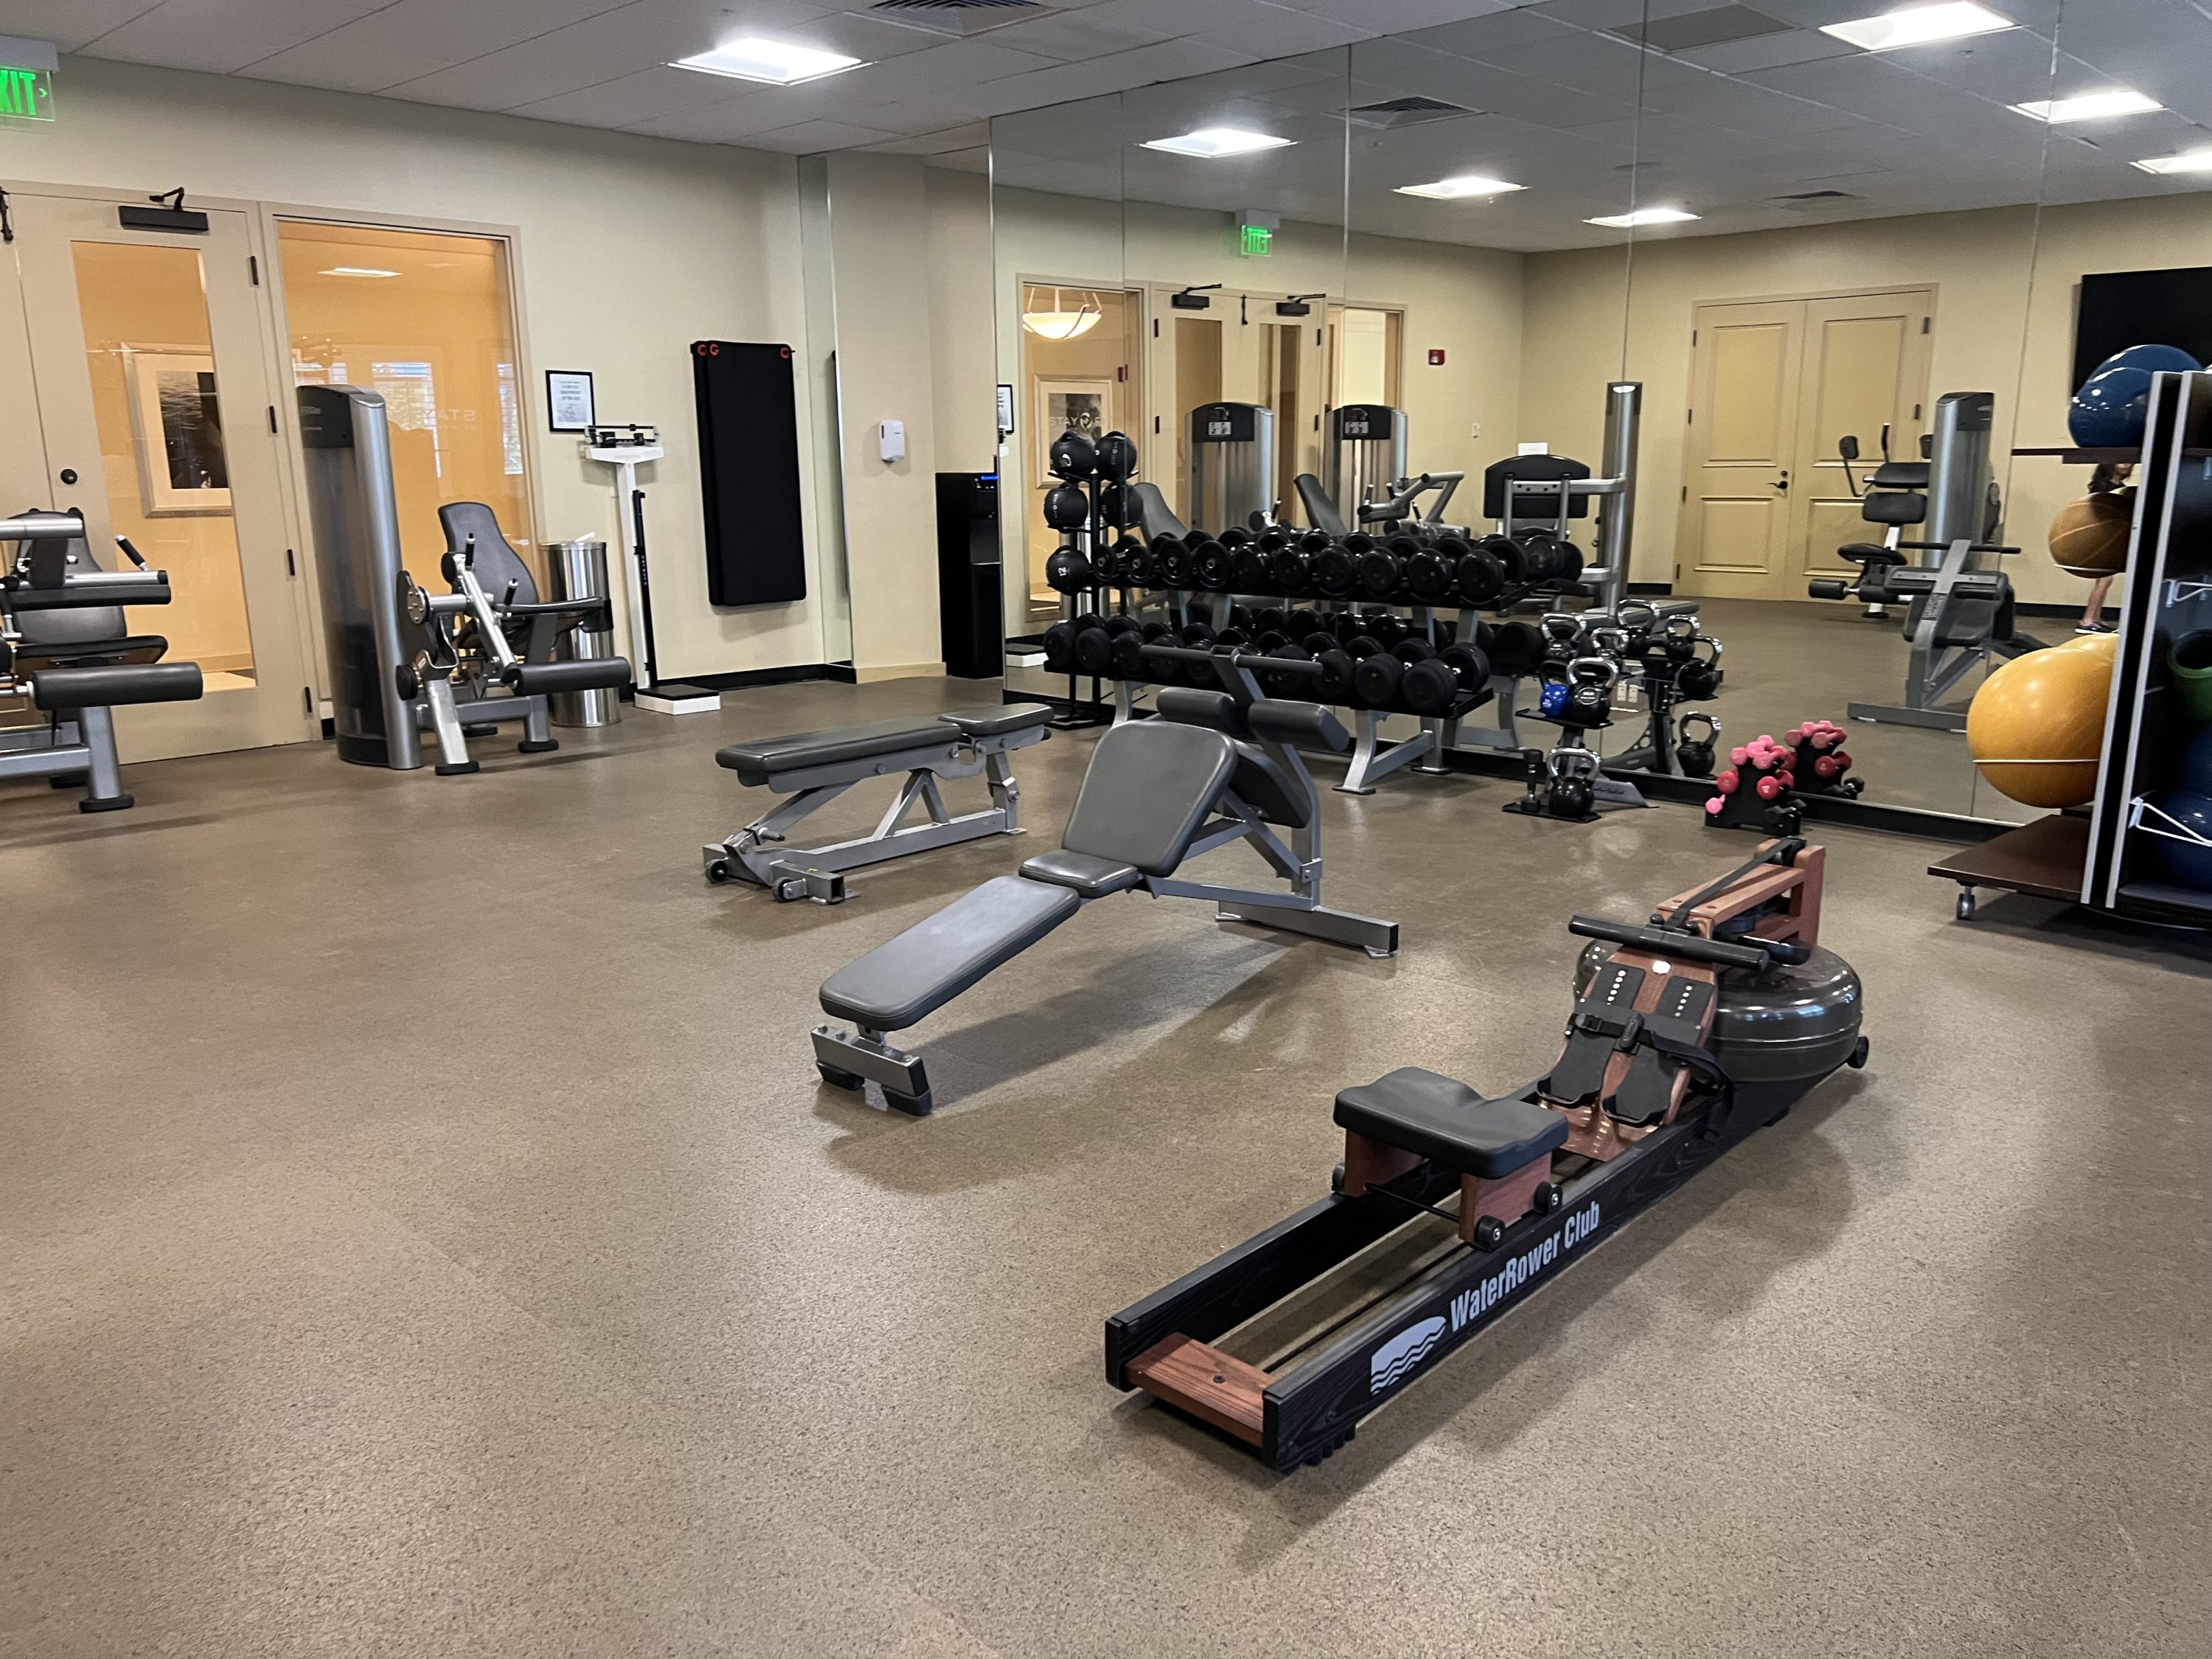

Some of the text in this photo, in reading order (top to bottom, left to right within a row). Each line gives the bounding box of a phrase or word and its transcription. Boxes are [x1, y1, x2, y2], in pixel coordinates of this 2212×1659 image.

[0, 69, 36, 116] XIT
[1450, 1201, 1599, 1332] WaterRower Club
